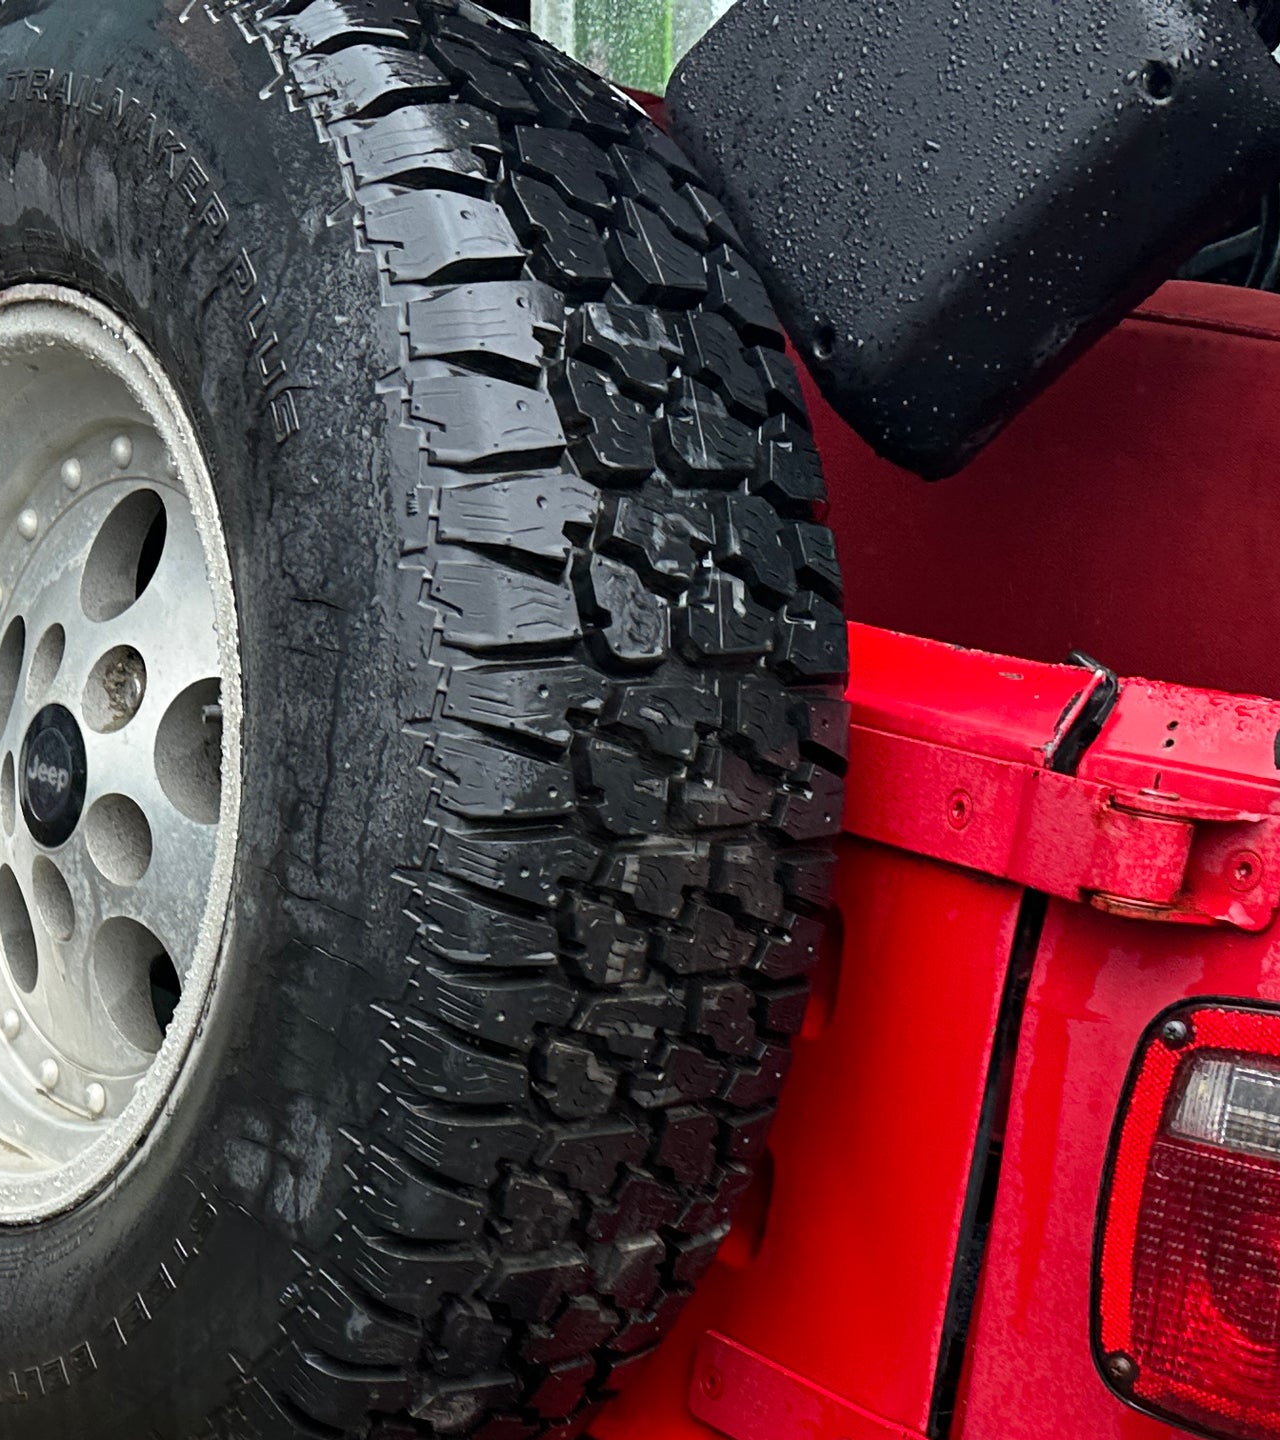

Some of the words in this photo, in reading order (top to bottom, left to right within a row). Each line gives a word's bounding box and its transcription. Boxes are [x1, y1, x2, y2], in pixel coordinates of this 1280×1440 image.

[6, 68, 229, 240] TRAILMAKER
[231, 247, 301, 444] PLUS
[28, 755, 70, 793] Jeep
